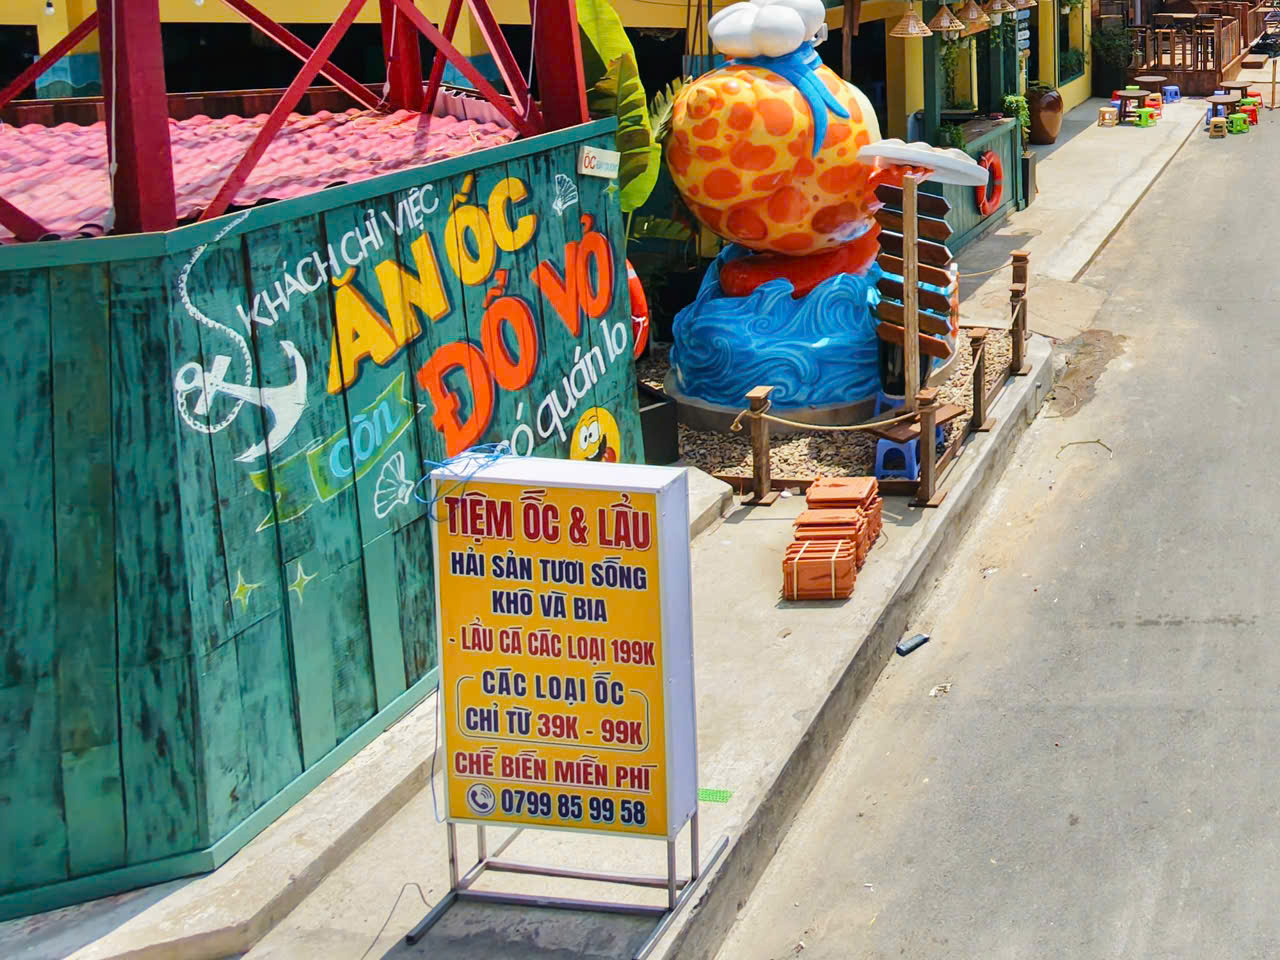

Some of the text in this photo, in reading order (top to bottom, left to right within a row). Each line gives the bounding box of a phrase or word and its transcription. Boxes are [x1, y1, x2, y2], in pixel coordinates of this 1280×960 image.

[236, 184, 440, 337] KHÁCH CHỈ VIỆC
[327, 172, 537, 395] ĂN ỐC
[531, 213, 614, 337] VỎ
[537, 345, 606, 442] quán
[444, 489, 651, 550] TIỆM ỐC & LẨU
[451, 547, 647, 589] HẢI SẢN TƯƠI SỐNG
[492, 589, 607, 622] KHÔ VÀ BIA
[461, 617, 493, 652] LẨU
[499, 626, 522, 654] CÁ
[528, 629, 561, 657] CÁC
[567, 635, 606, 665] LOẠI
[611, 639, 655, 666] 199K
[482, 668, 624, 705] CÁC LOẠI ỐC
[465, 703, 499, 732] CHỈ
[506, 706, 532, 735] TỪ
[537, 714, 578, 740] 39K
[601, 719, 643, 745] 99K
[455, 746, 658, 790] CHẾ BIẾN MIỄN PHÍ
[501, 789, 646, 825] 0799 85 99 58
